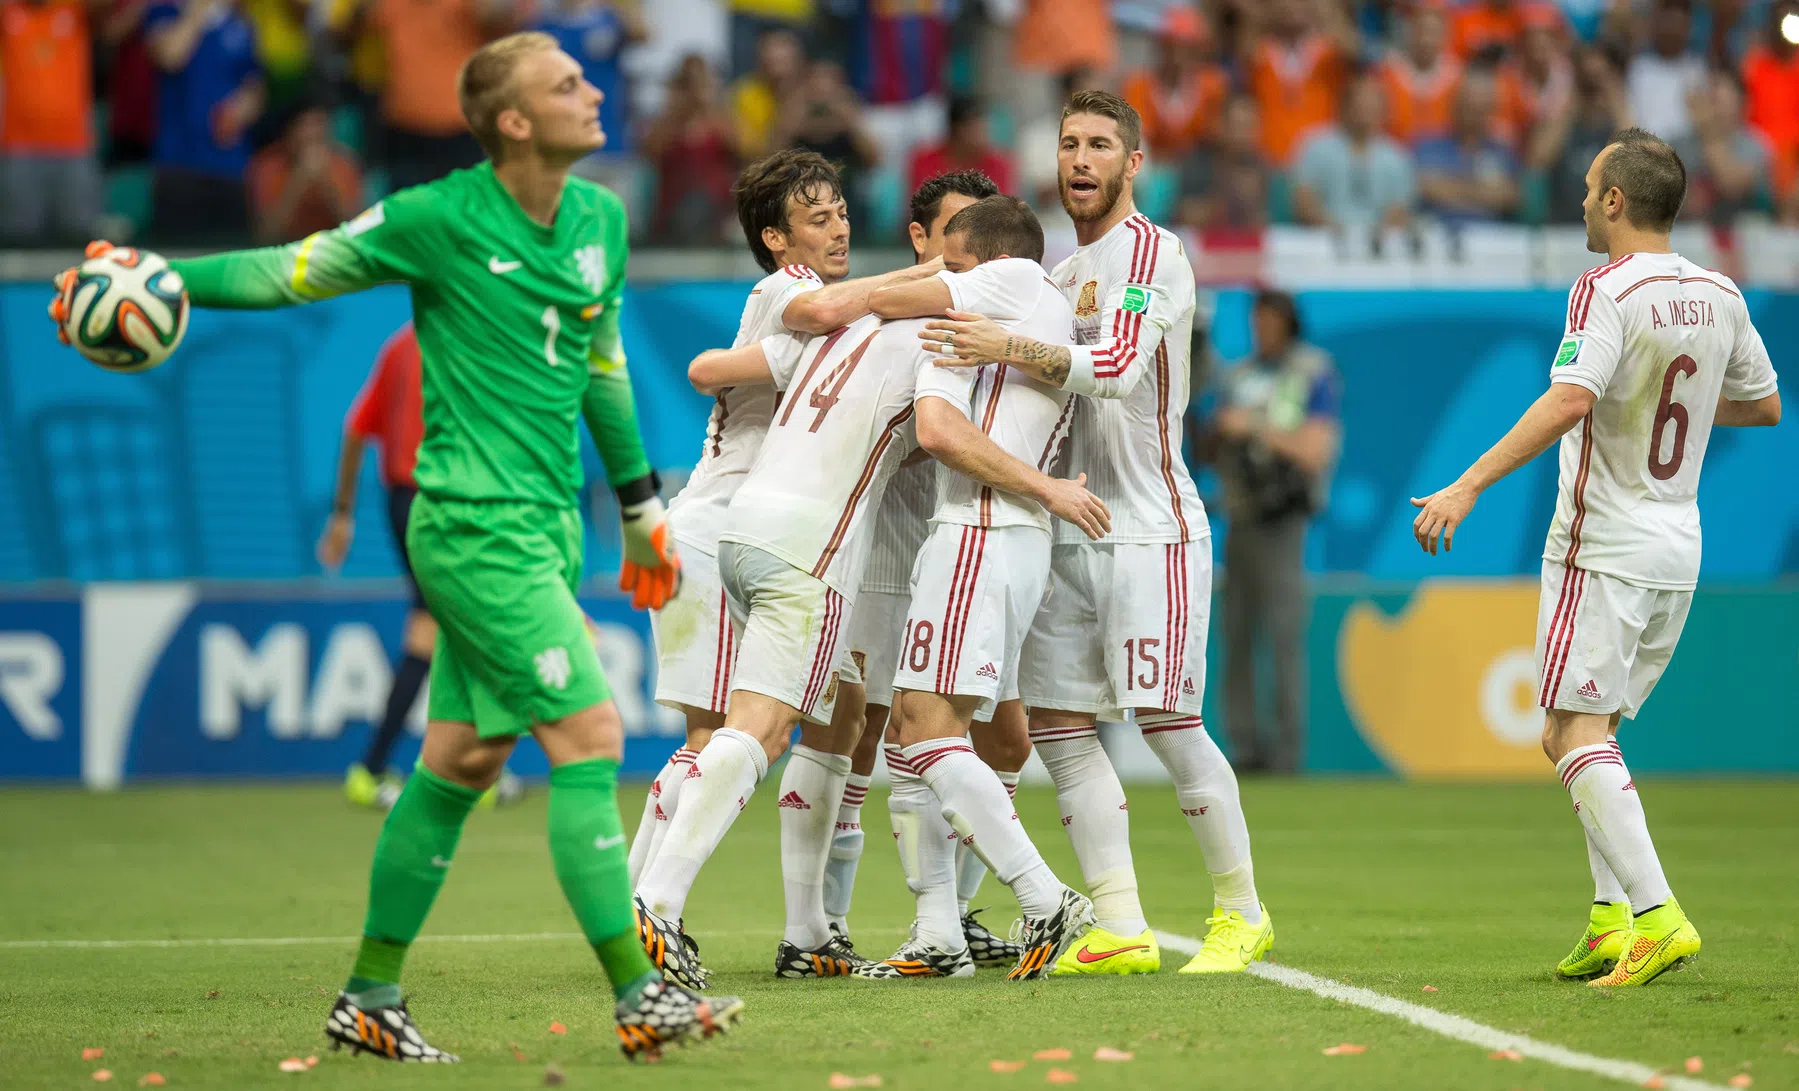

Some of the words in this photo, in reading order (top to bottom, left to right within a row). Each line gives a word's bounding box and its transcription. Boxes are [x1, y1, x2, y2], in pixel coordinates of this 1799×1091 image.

[541, 305, 561, 367] 1
[1651, 304, 1667, 330] A.
[779, 326, 882, 433] 14
[1648, 354, 1698, 480] 6
[900, 618, 934, 672] 18
[1122, 638, 1160, 690] 15
[976, 670, 999, 681] adidas
[1576, 689, 1602, 699] adidas
